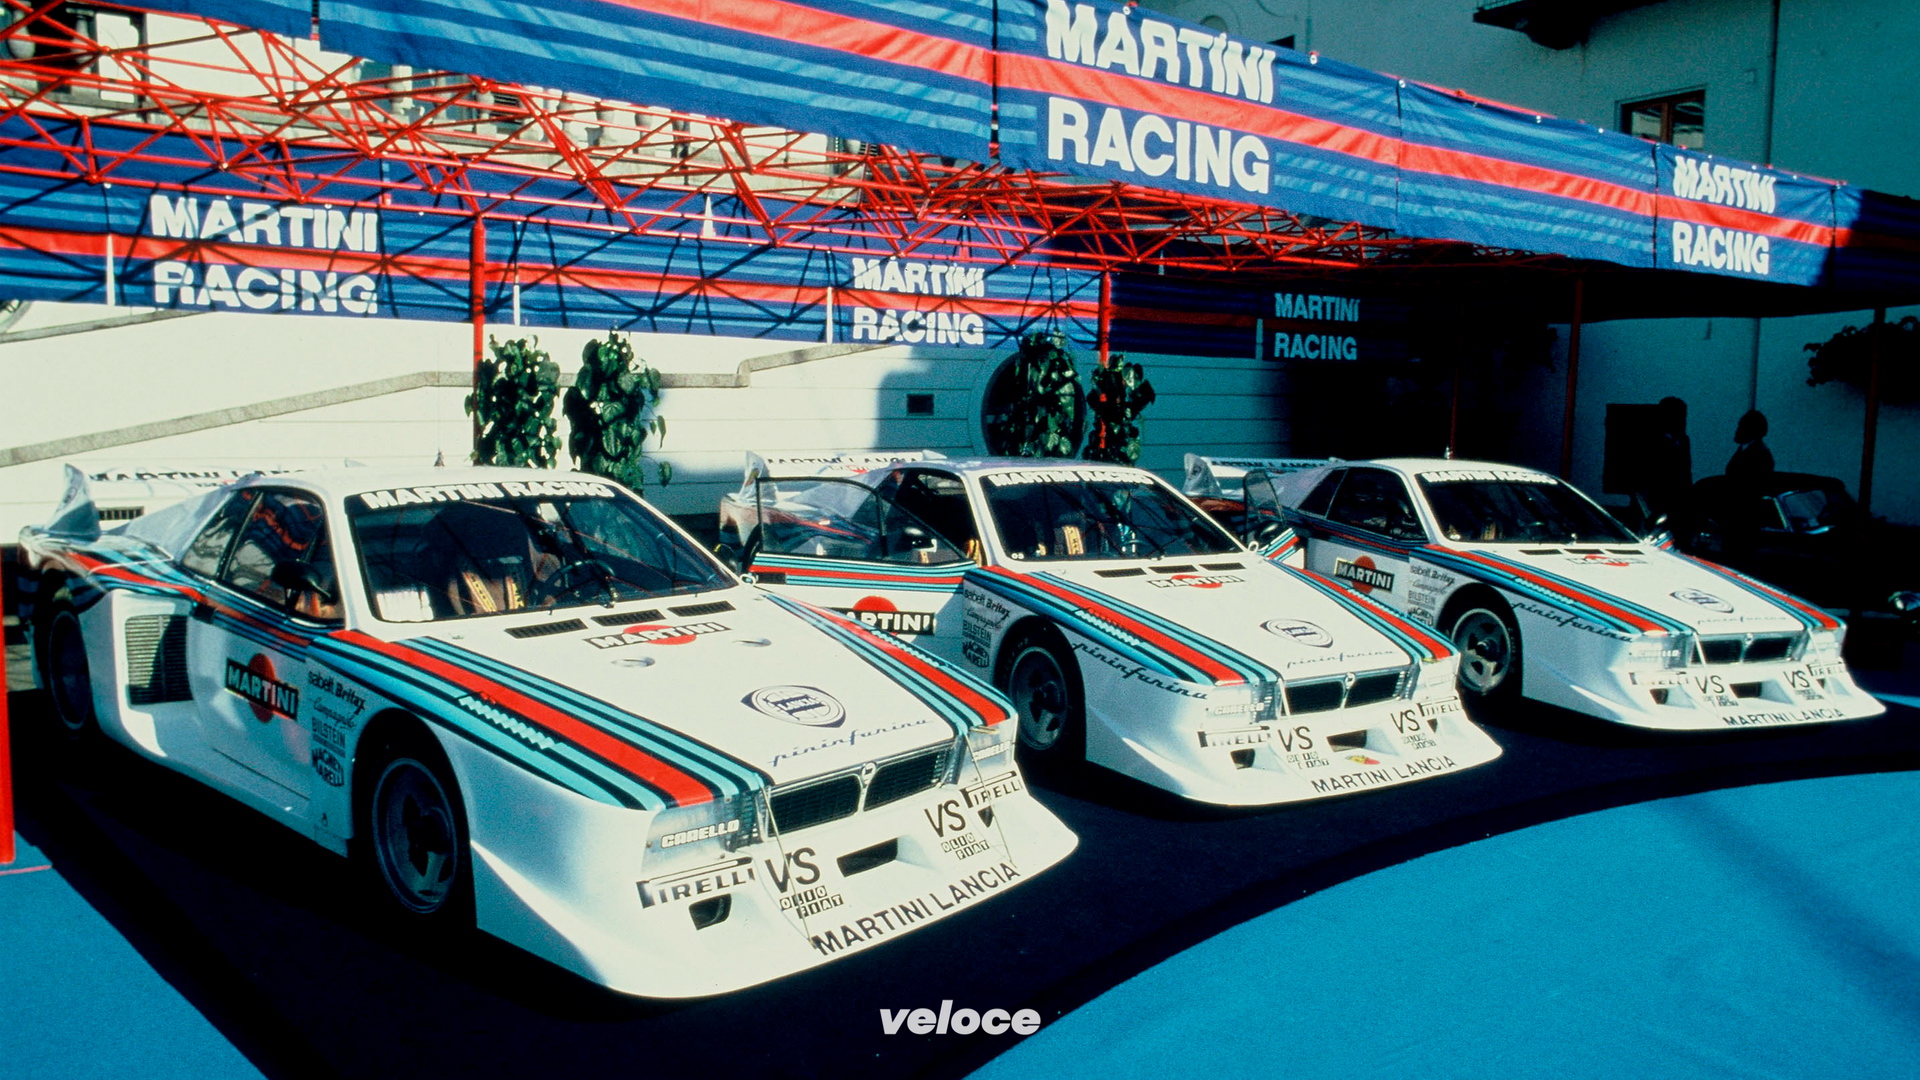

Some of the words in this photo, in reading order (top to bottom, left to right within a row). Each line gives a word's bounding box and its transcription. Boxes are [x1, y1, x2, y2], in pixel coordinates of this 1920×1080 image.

[1046, 0, 1276, 104] MARTINI
[1048, 97, 1270, 195] RACING
[1673, 155, 1776, 214] MARTINI
[150, 194, 378, 252] MARTINI
[1672, 221, 1769, 275] RACING
[154, 261, 378, 315] RACING
[852, 257, 985, 297] MARTINI
[1274, 292, 1361, 322] MARTINI
[852, 306, 984, 345] RACING
[1274, 332, 1357, 360] RACING
[988, 471, 1079, 487] MARTINI
[361, 484, 504, 509] MARTINI
[502, 481, 615, 498] RACING
[1338, 560, 1392, 589] MARTINI
[589, 622, 727, 649] MARTINI
[846, 611, 931, 632] ARTINI
[963, 620, 992, 641] BILSTEIN
[228, 664, 298, 715] MARTINI
[1695, 675, 1724, 694] VS
[1783, 670, 1811, 688] VS
[335, 682, 366, 716] Britax
[1390, 709, 1421, 734] VS
[1722, 712, 1793, 726] MARTINI
[1789, 707, 1845, 722] LANCIA
[312, 716, 346, 749] BILSTEIN
[1277, 726, 1313, 752] VS
[1311, 768, 1393, 794] MARTINI
[1392, 755, 1458, 780] LANCIA
[661, 819, 740, 849] CARELLO
[924, 800, 967, 838] VS
[941, 832, 976, 854] OLIO
[955, 839, 990, 860] FIAT
[765, 847, 821, 894] VS
[779, 885, 828, 911] OLIO
[796, 894, 844, 920] FIAT
[811, 898, 934, 956] MARTINI
[930, 862, 1021, 912] LANCIA
